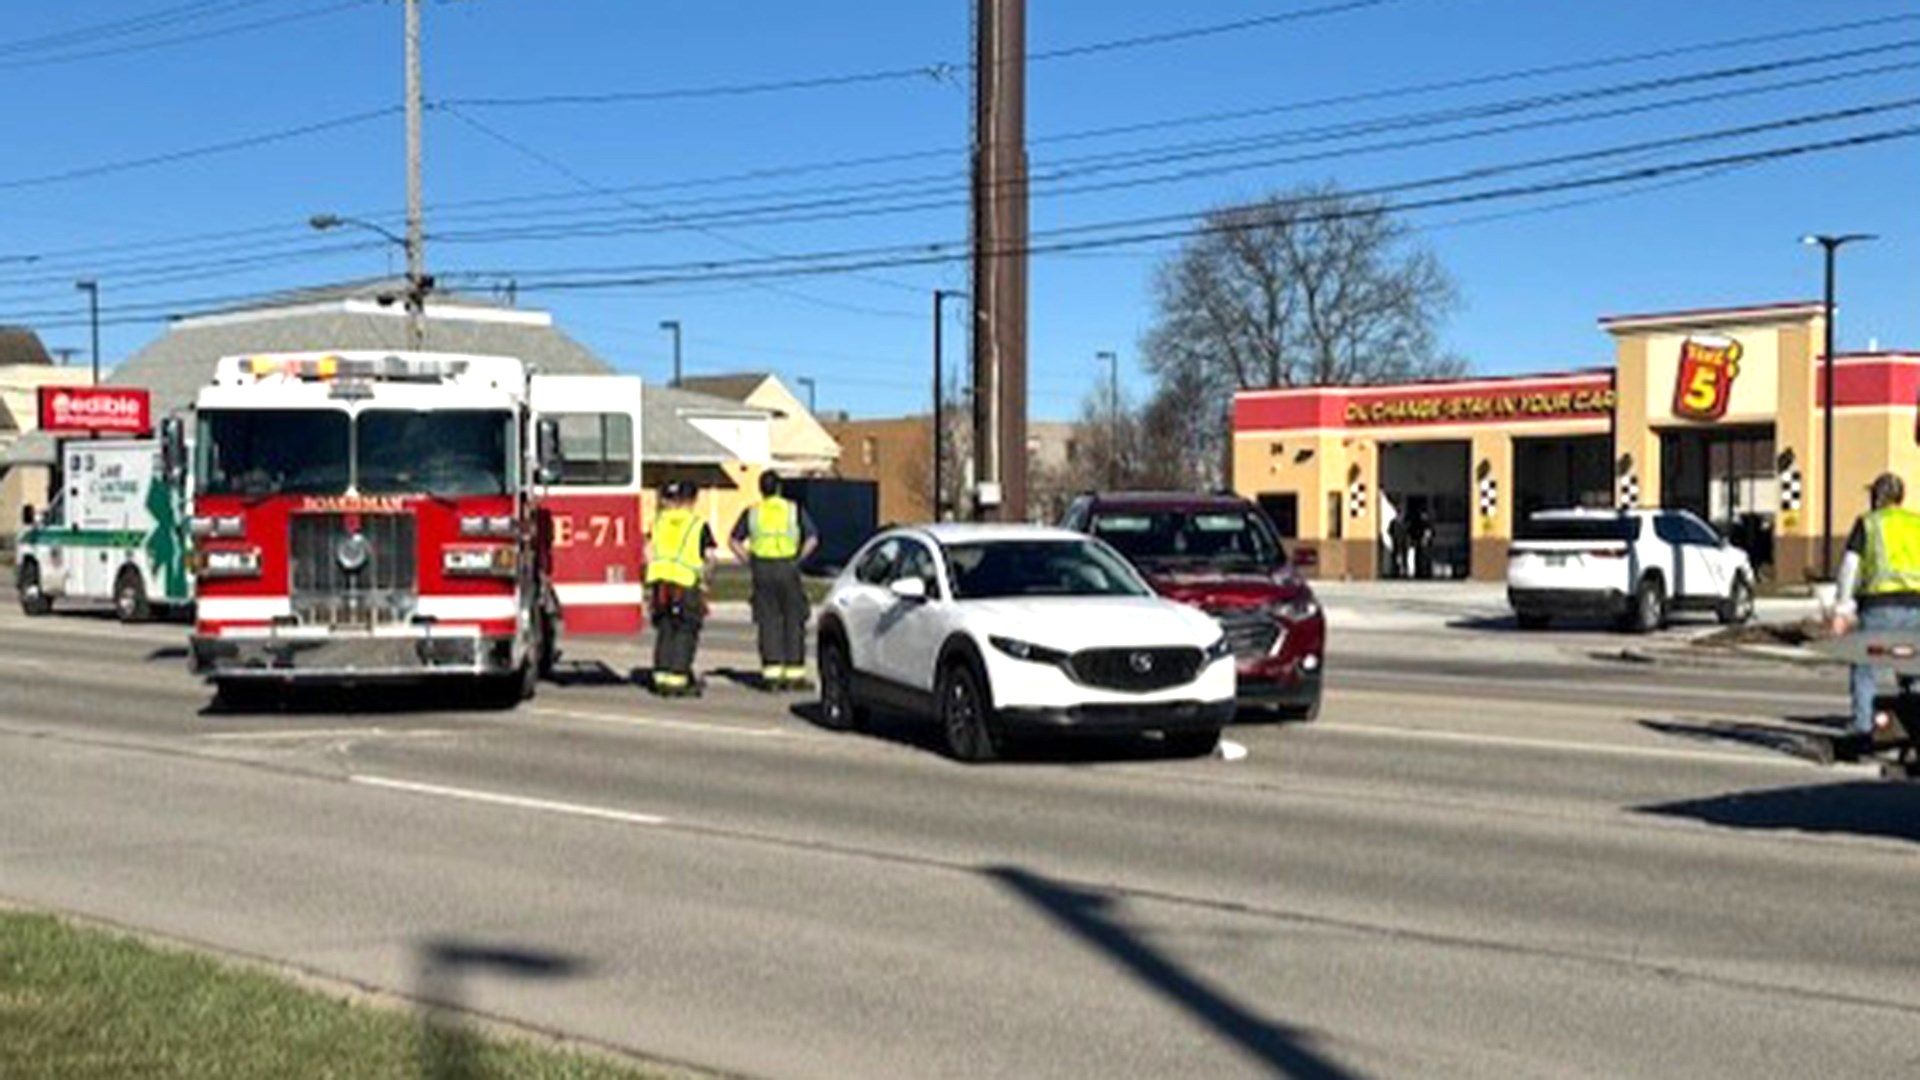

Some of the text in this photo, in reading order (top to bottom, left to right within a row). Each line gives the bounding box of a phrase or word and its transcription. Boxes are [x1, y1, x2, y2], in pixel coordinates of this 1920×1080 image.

[1518, 391, 1571, 413] YOUR
[1683, 366, 1717, 409] 5
[553, 515, 625, 547] E-71
